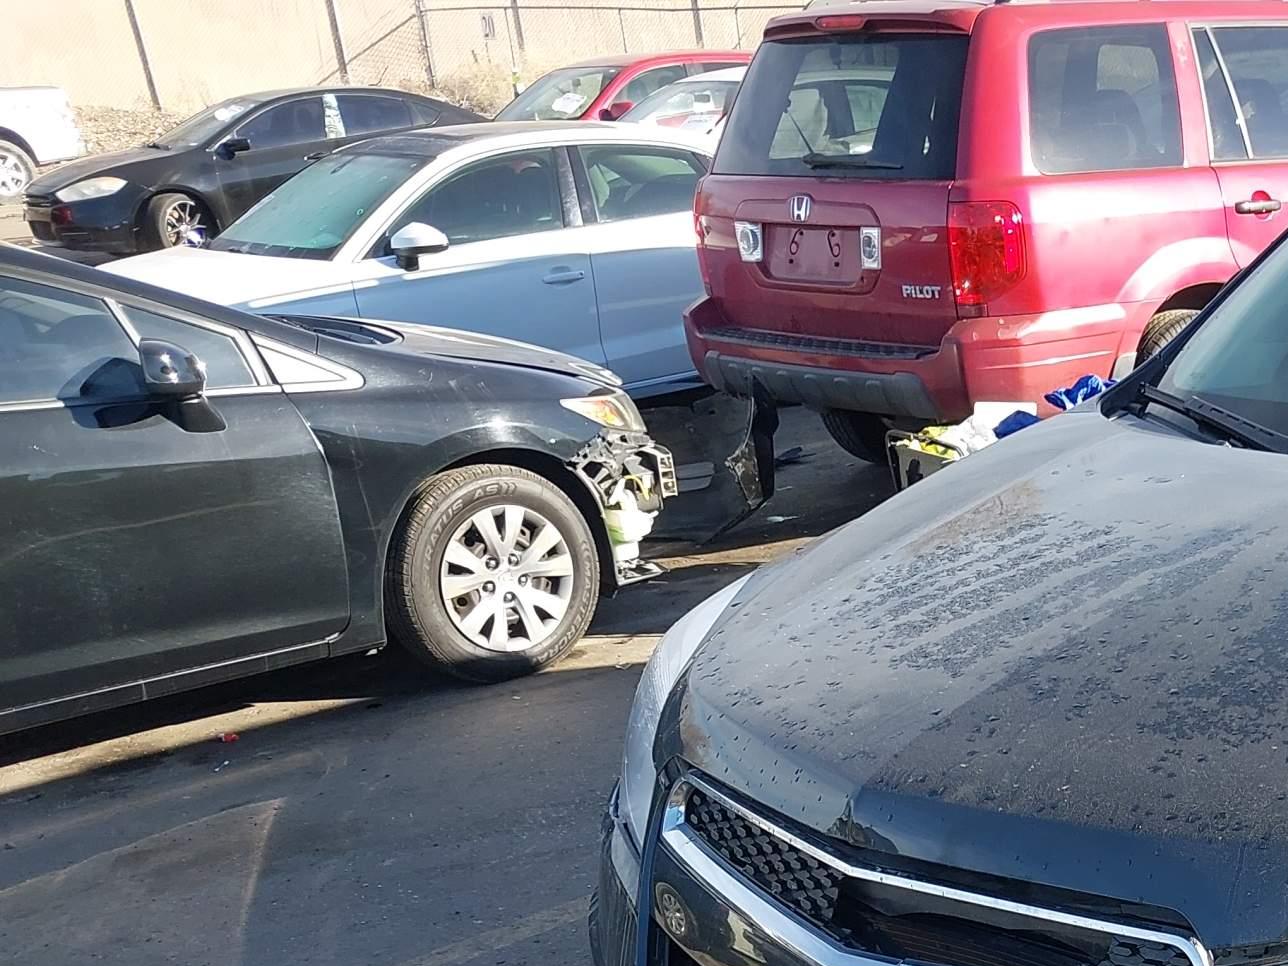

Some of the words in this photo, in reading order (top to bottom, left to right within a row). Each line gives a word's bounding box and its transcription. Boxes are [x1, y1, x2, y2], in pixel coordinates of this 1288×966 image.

[902, 284, 942, 299] PILOT
[421, 498, 464, 588] STRATUS
[473, 482, 500, 501] AS
[533, 559, 592, 666] MASTERCRA
